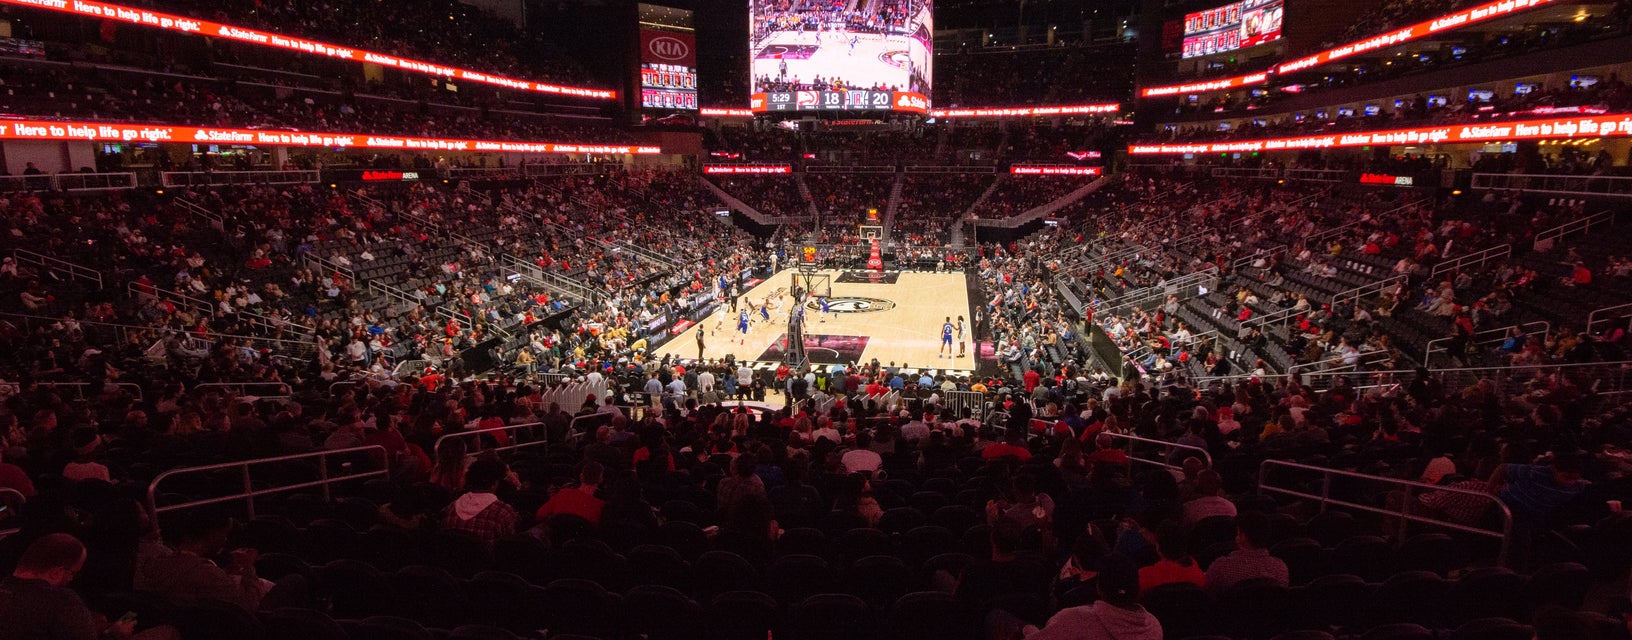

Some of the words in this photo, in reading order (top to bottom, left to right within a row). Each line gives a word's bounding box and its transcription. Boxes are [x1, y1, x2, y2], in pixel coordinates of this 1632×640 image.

[74, 0, 102, 14] Here
[103, 6, 115, 17] to
[117, 8, 140, 22] help
[142, 11, 159, 24] life
[160, 17, 174, 28] go
[175, 18, 201, 31] right.
[271, 35, 290, 47] Here
[290, 40, 299, 49] to
[300, 40, 315, 53] help
[315, 43, 327, 53] life
[327, 47, 336, 56] go
[656, 41, 682, 56] KIA
[772, 93, 790, 104] 5:29
[825, 93, 839, 105] 18
[873, 92, 889, 105] 20
[14, 123, 47, 137] Here
[49, 125, 65, 137] to
[67, 124, 97, 140] help
[98, 125, 120, 138] life
[122, 129, 138, 141] go
[140, 127, 172, 142] right.
[1515, 124, 1540, 136] Here
[1540, 123, 1553, 135] to
[1553, 121, 1578, 137] help
[1578, 119, 1599, 134] life
[1599, 121, 1617, 136] go
[258, 132, 280, 143] Here
[280, 133, 290, 144] to
[291, 133, 309, 146] help
[309, 134, 322, 145] life
[323, 137, 333, 147] go
[1395, 176, 1413, 185] ARENA
